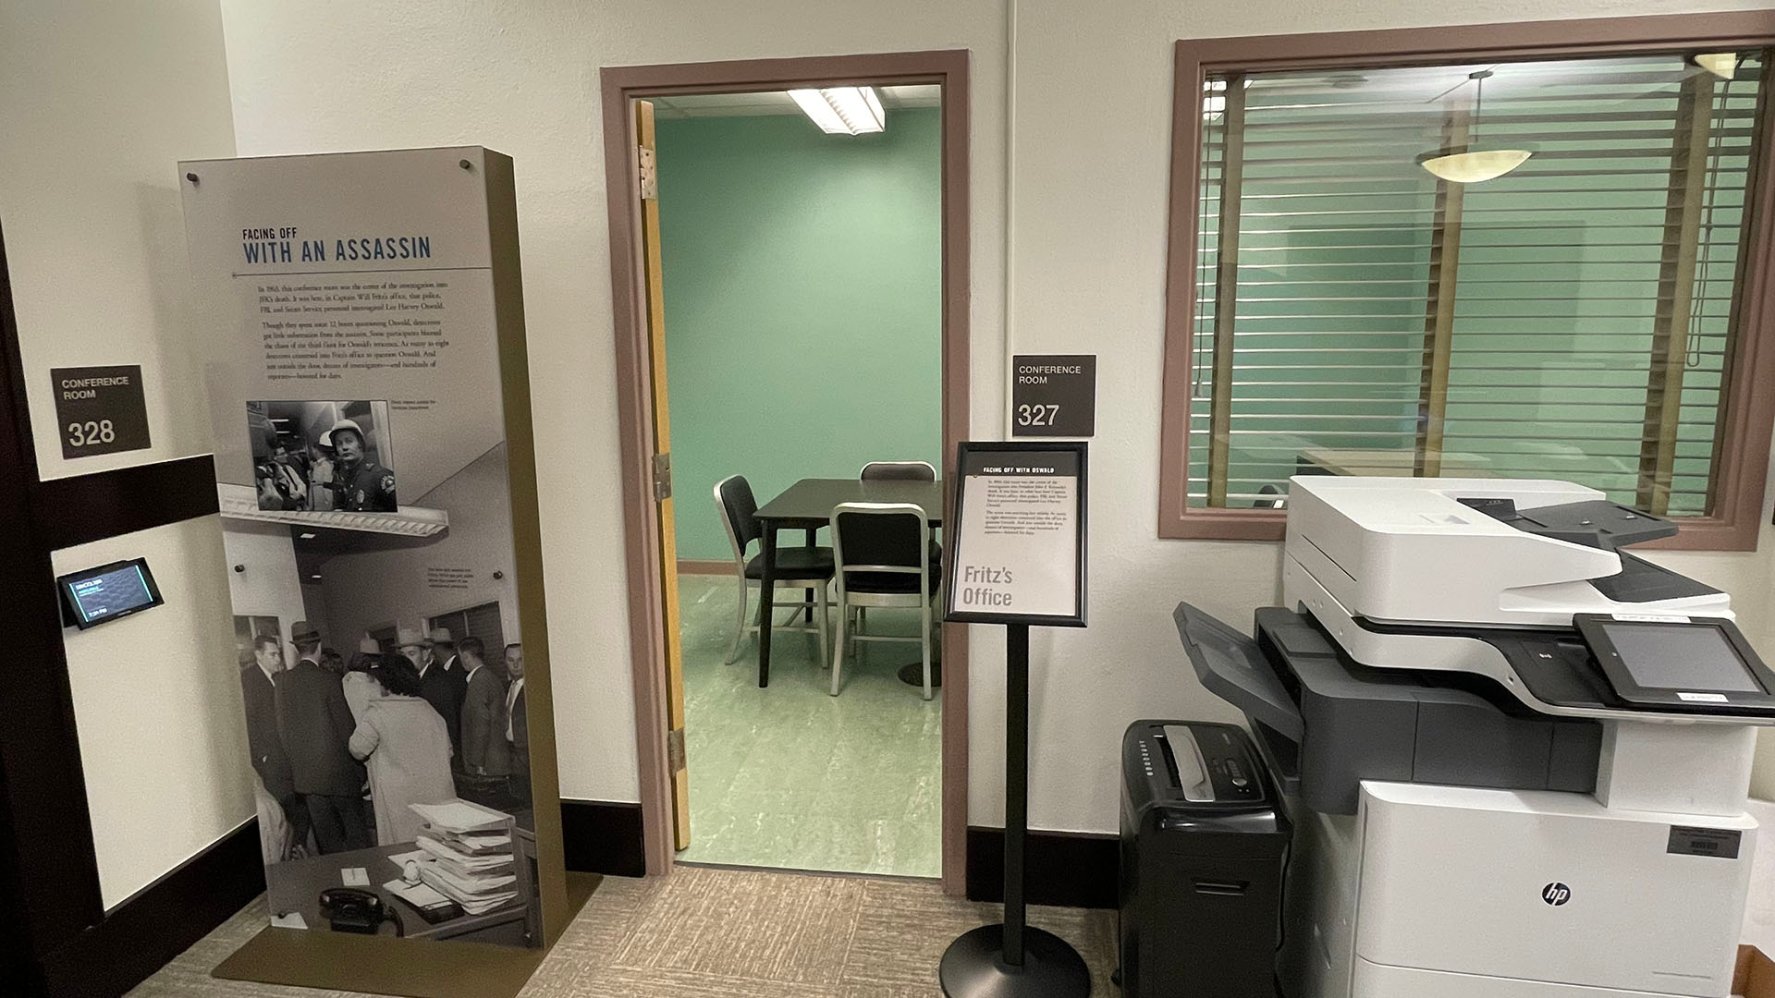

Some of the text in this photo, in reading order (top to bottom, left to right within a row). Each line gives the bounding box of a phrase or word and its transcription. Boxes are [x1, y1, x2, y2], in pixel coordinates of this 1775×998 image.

[242, 227, 297, 240] FACING OFF
[243, 236, 431, 264] WITH AN ASSASSIN
[1018, 365, 1082, 375] CONFERENCE
[61, 376, 130, 389] CONFERENCE
[1018, 376, 1048, 384] ROOM
[63, 389, 97, 400] ROOM
[1018, 404, 1060, 426] 327
[68, 419, 116, 447] 328
[964, 566, 1013, 584] Fritz's
[963, 587, 1012, 606] Office
[1545, 882, 1568, 906] hp
